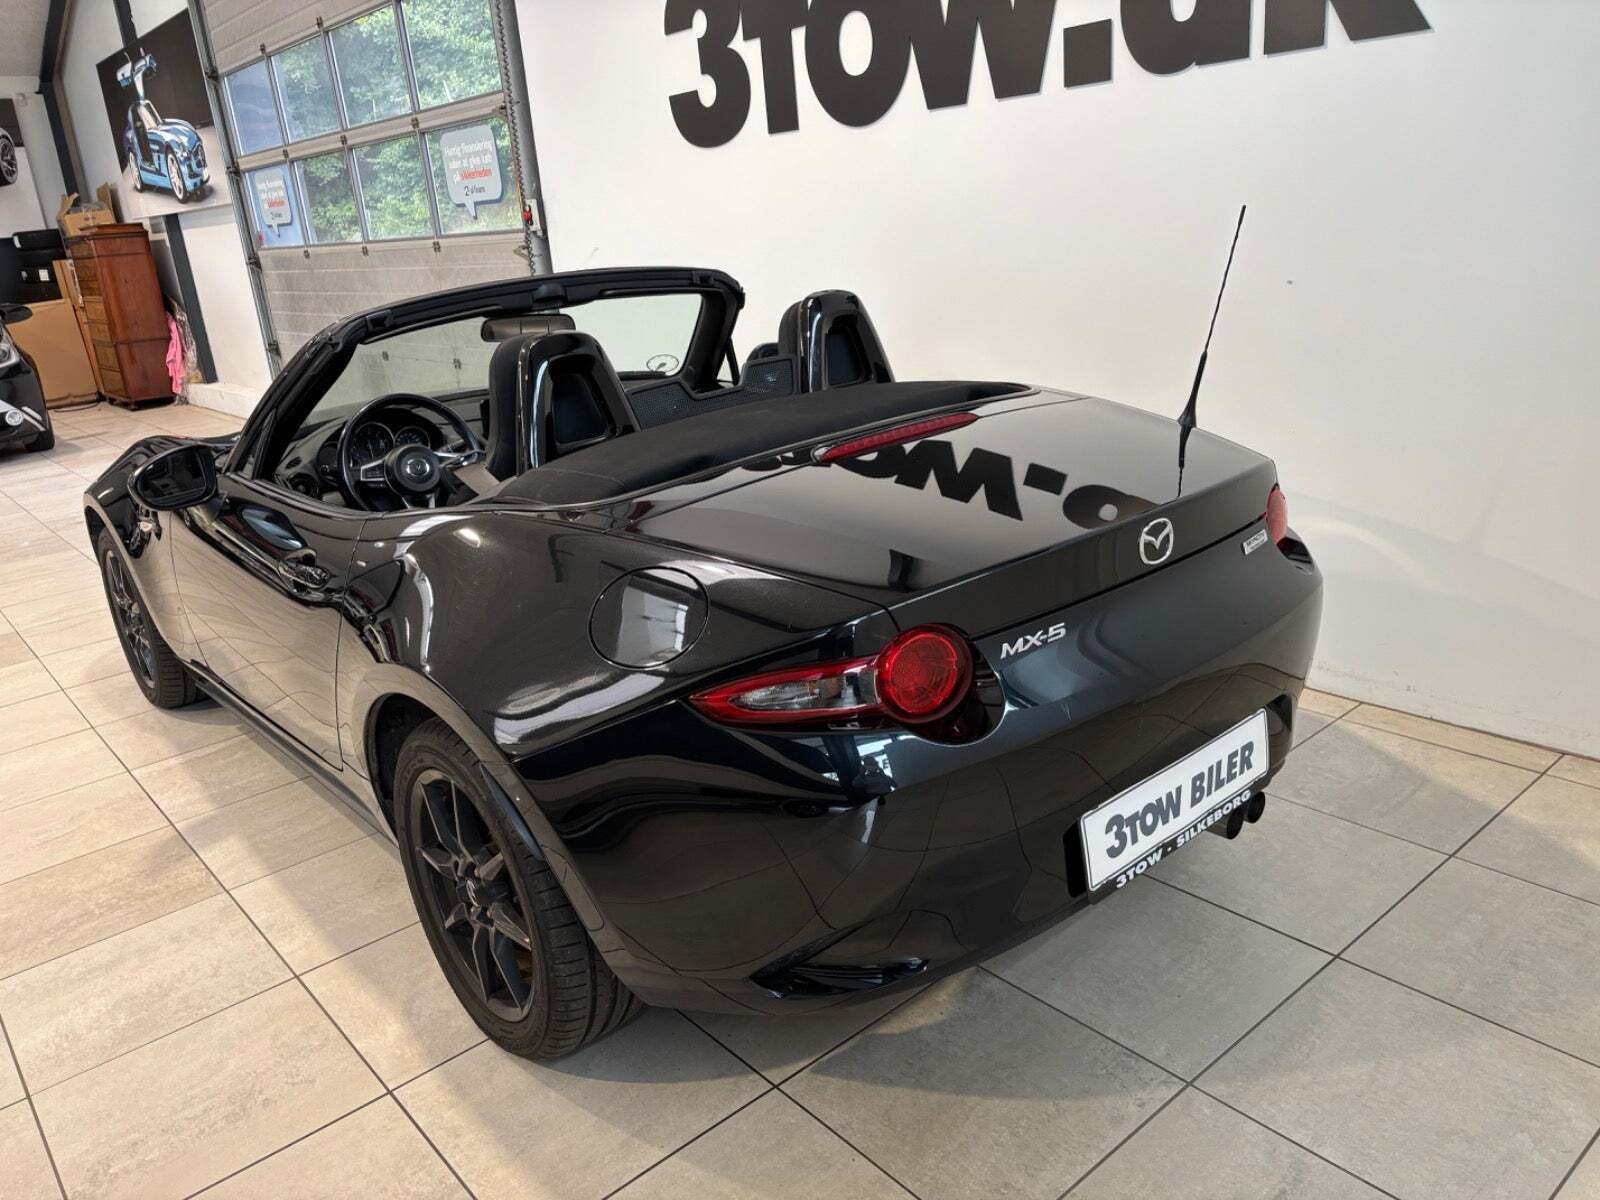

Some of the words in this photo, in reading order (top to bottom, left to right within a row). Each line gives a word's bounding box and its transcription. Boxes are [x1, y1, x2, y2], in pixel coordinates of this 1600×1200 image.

[1000, 622, 1066, 659] MX-5
[1105, 784, 1182, 858] 3TOW
[1190, 741, 1254, 809] BILER
[1116, 846, 1163, 888] 3TOW
[1176, 789, 1251, 848] SILKEBORG
